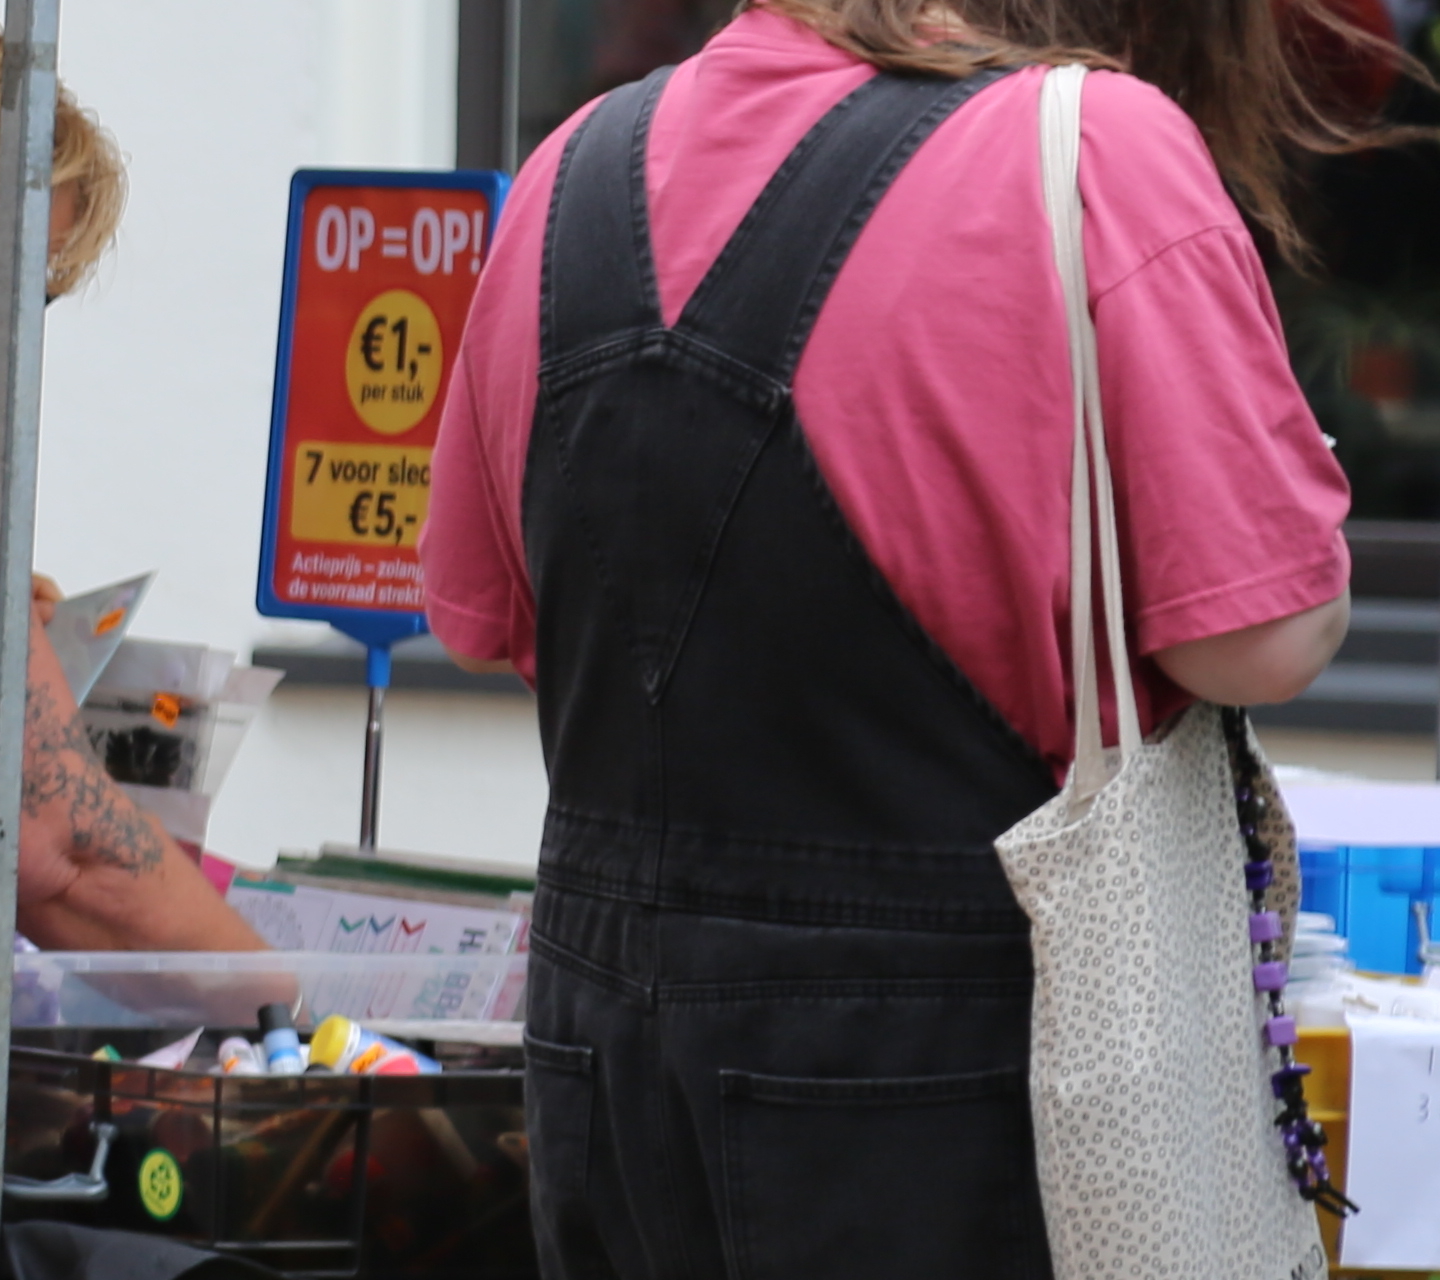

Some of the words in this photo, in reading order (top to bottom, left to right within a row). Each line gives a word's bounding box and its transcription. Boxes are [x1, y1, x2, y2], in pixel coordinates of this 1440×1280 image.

[315, 204, 375, 272] OP
[412, 206, 484, 276] OP!
[360, 314, 432, 381] €1,-
[361, 384, 386, 405] per
[391, 383, 425, 402] stuk
[306, 449, 324, 486] 7
[331, 459, 381, 483] voor
[350, 490, 417, 546] €5,-
[293, 552, 361, 580] Actieprijs
[289, 577, 308, 599] de
[311, 581, 376, 603] voorraad
